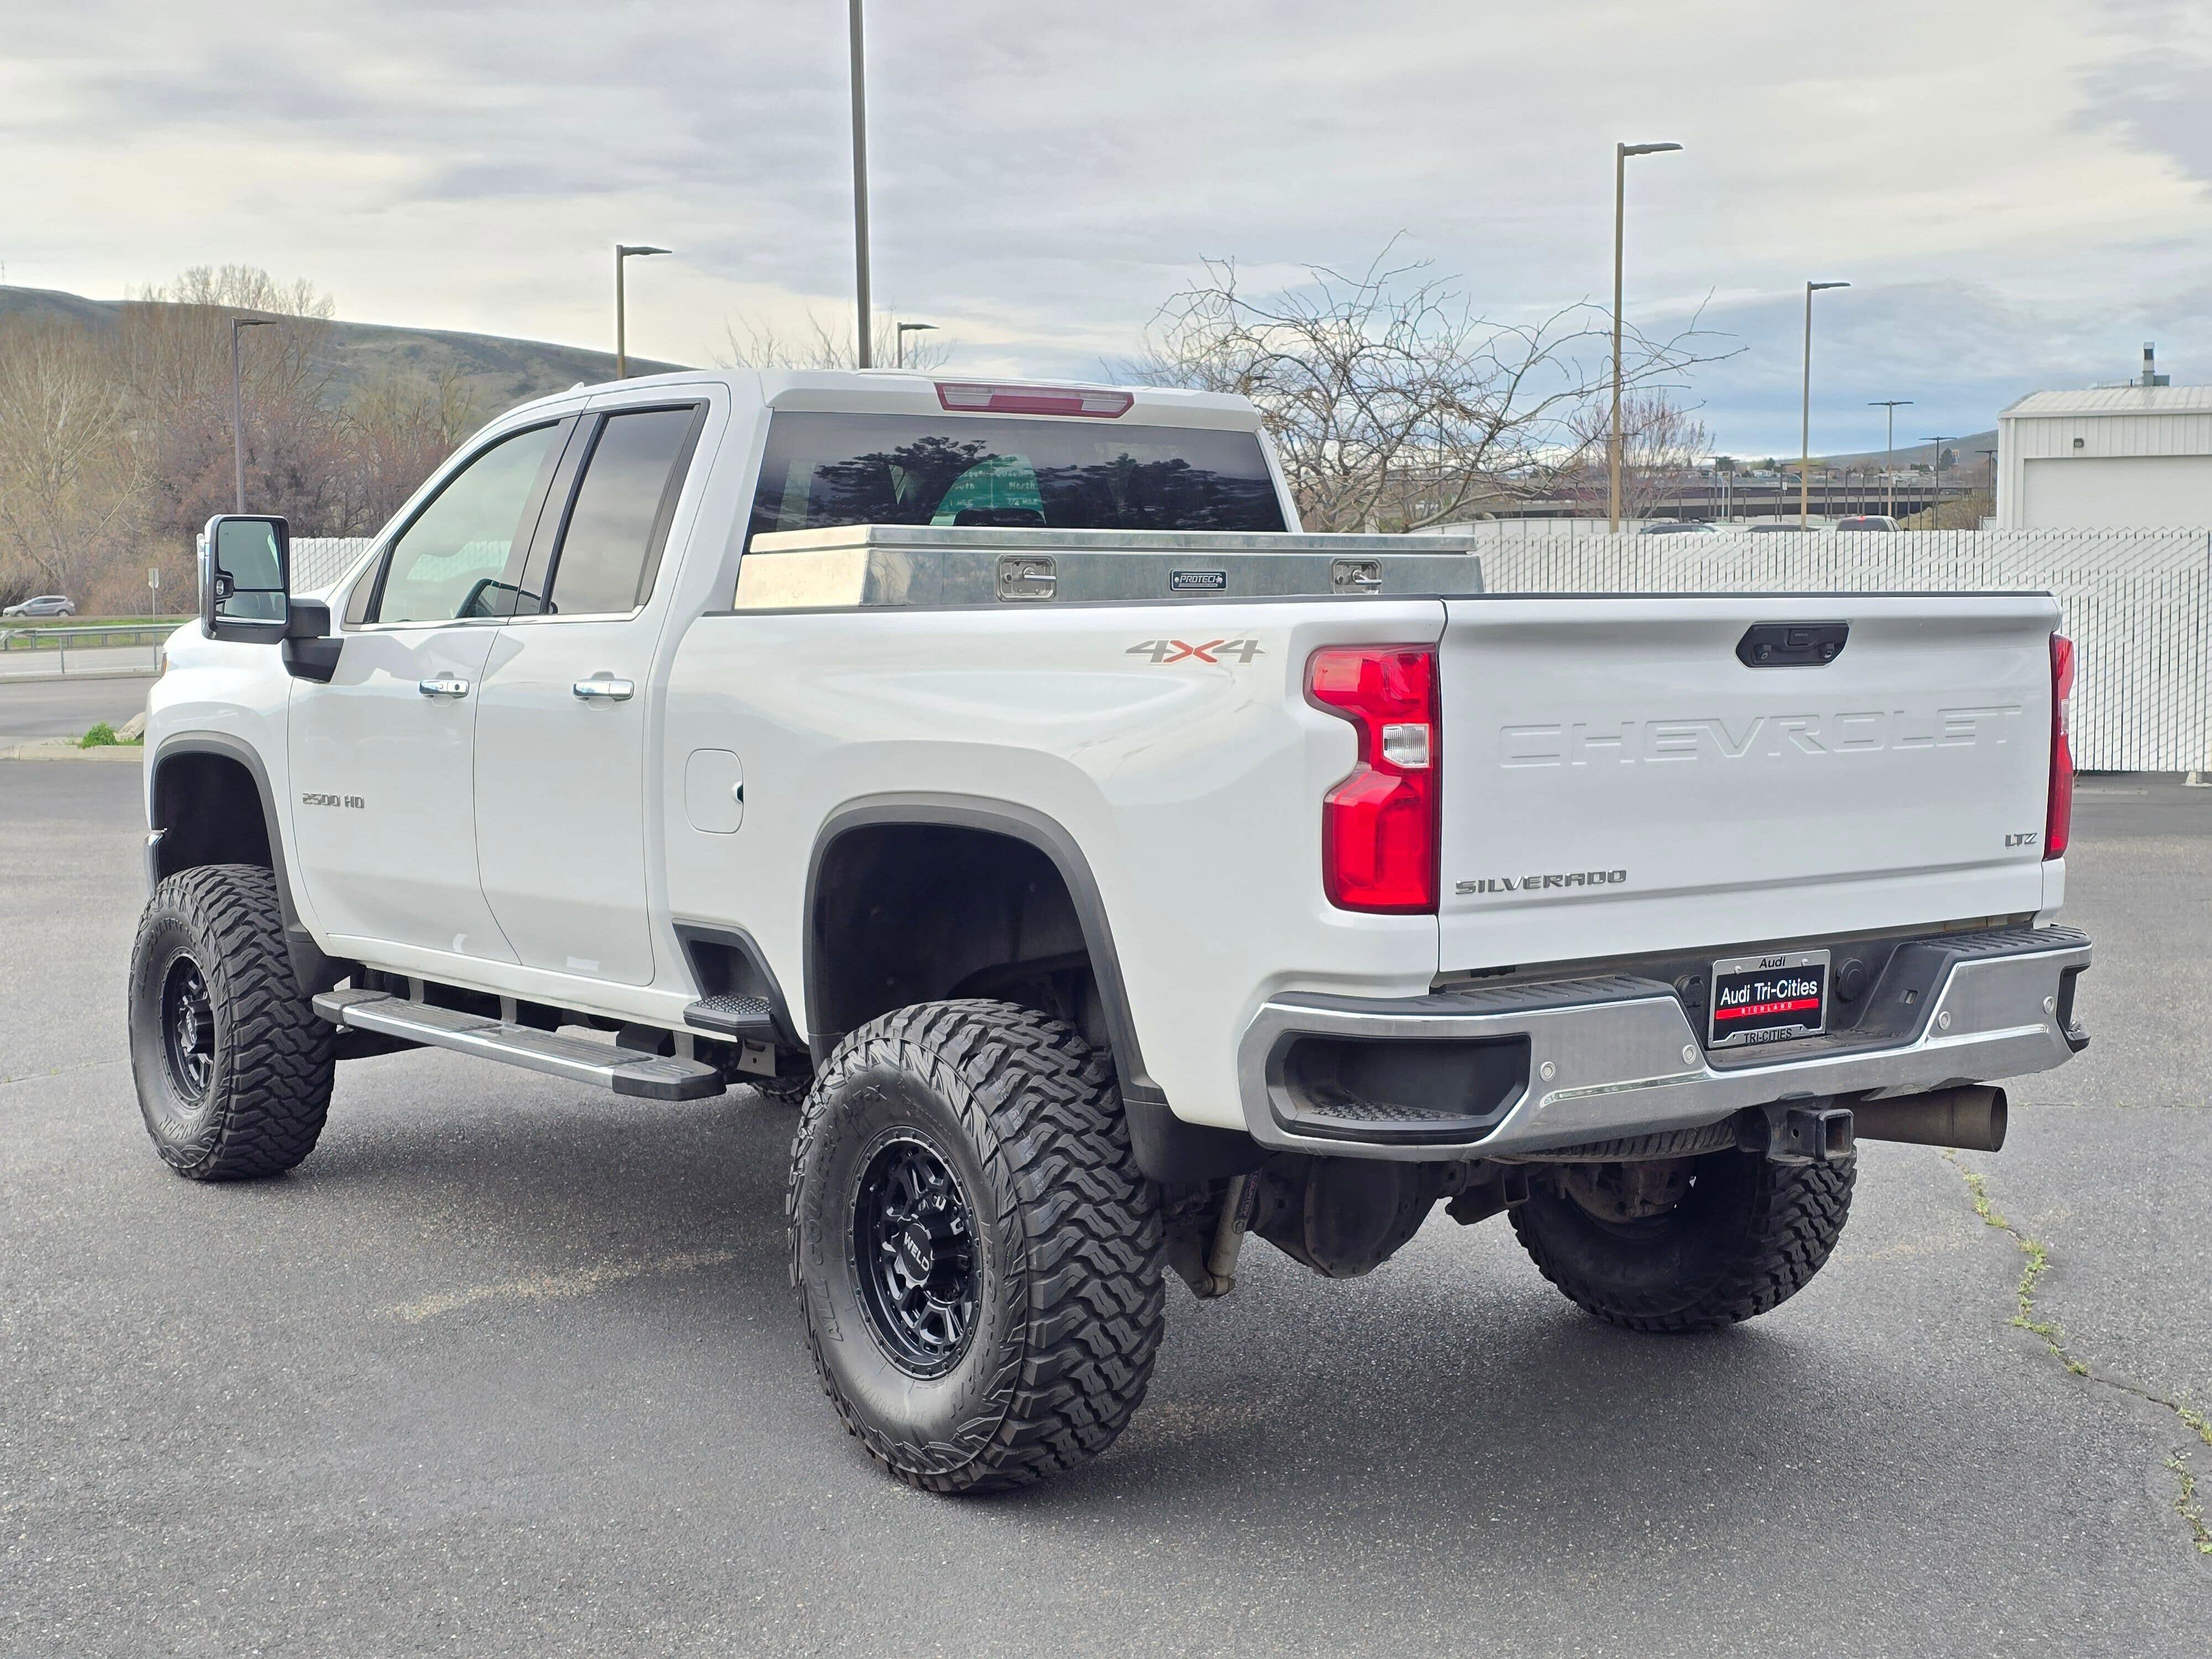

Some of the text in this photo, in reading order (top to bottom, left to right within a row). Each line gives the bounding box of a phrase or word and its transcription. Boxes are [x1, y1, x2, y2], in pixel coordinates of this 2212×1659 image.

[1009, 482, 1036, 490] North
[1499, 705, 2022, 769] CHEVROLET
[302, 792, 365, 809] 2500 HD
[2005, 832, 2037, 847] LTZ
[1455, 868, 1627, 895] SILVERADO
[1759, 956, 1787, 968] Audi
[1720, 978, 1818, 1005] Audi Tri-Cities
[1743, 1028, 1792, 1044] TRI-CITIES
[904, 1232, 930, 1272] WELD
